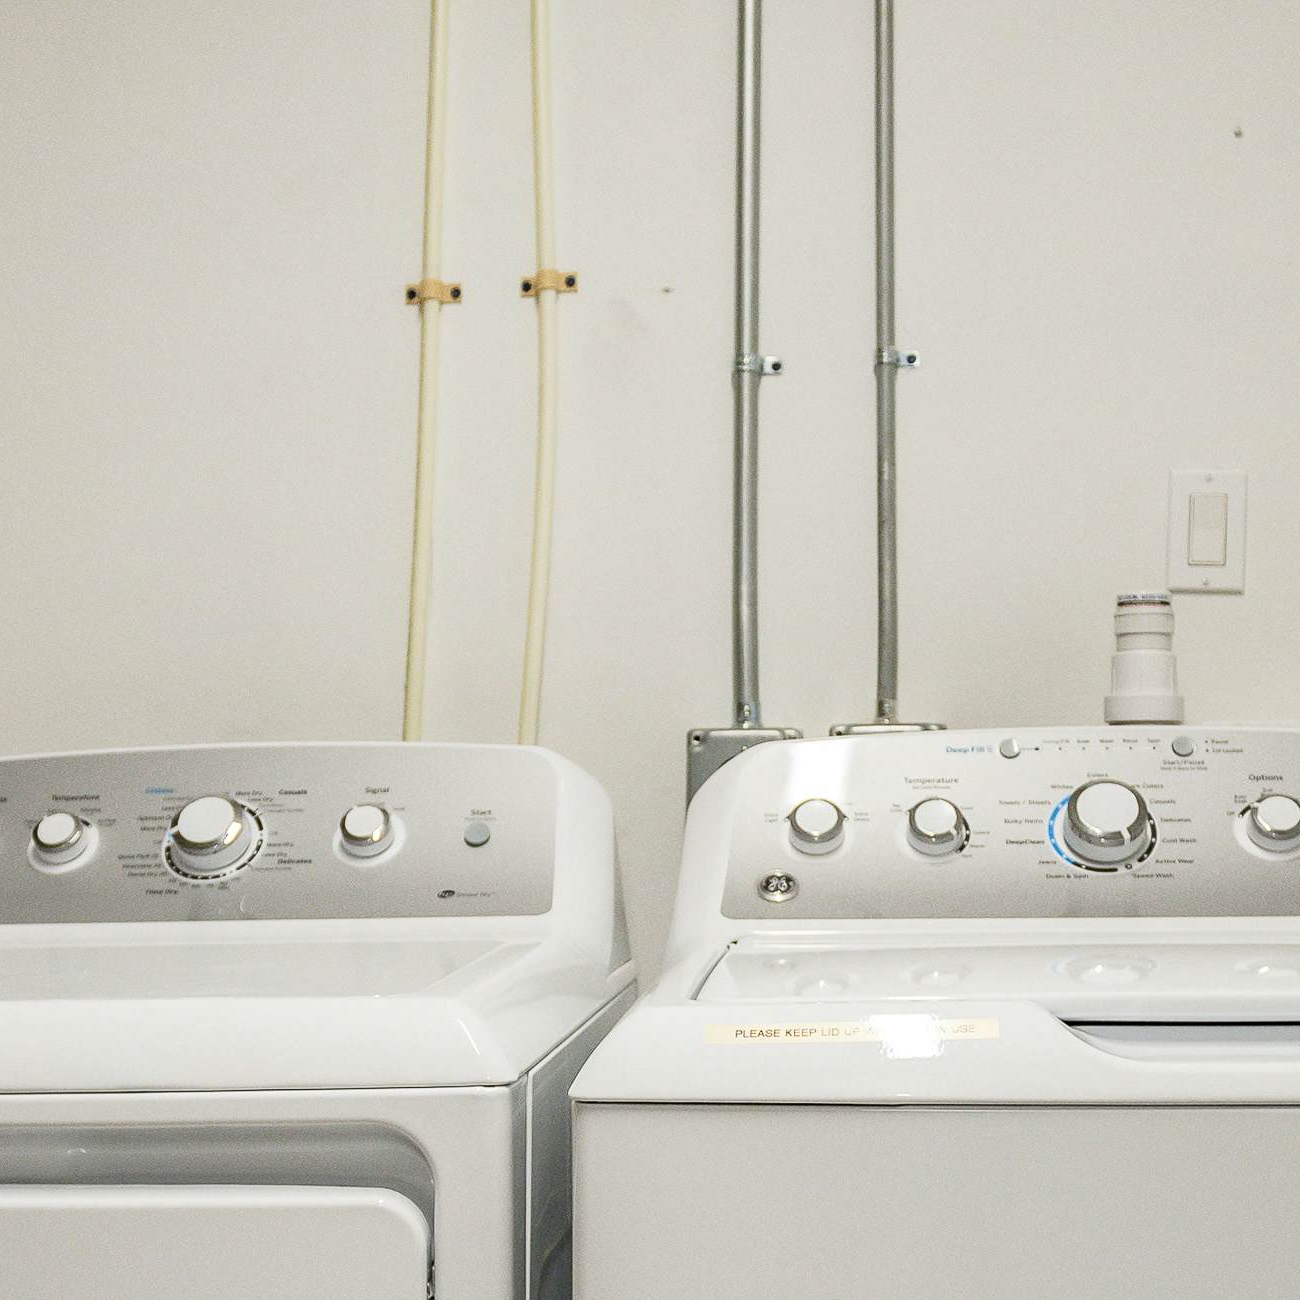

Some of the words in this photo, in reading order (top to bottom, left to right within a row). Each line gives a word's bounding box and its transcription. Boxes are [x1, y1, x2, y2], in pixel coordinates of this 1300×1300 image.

[945, 745, 970, 754] Deep
[971, 745, 986, 753] Fill
[904, 776, 960, 785] Temperature
[1248, 774, 1285, 783] Options
[278, 788, 308, 796] Casuals
[364, 785, 390, 795] Signal
[51, 793, 100, 802] Temperature
[470, 808, 492, 816] Start
[734, 1029, 781, 1038] PLEASE
[785, 1028, 817, 1037] KEEP
[821, 1027, 840, 1037] LID
[843, 1027, 860, 1036] UP
